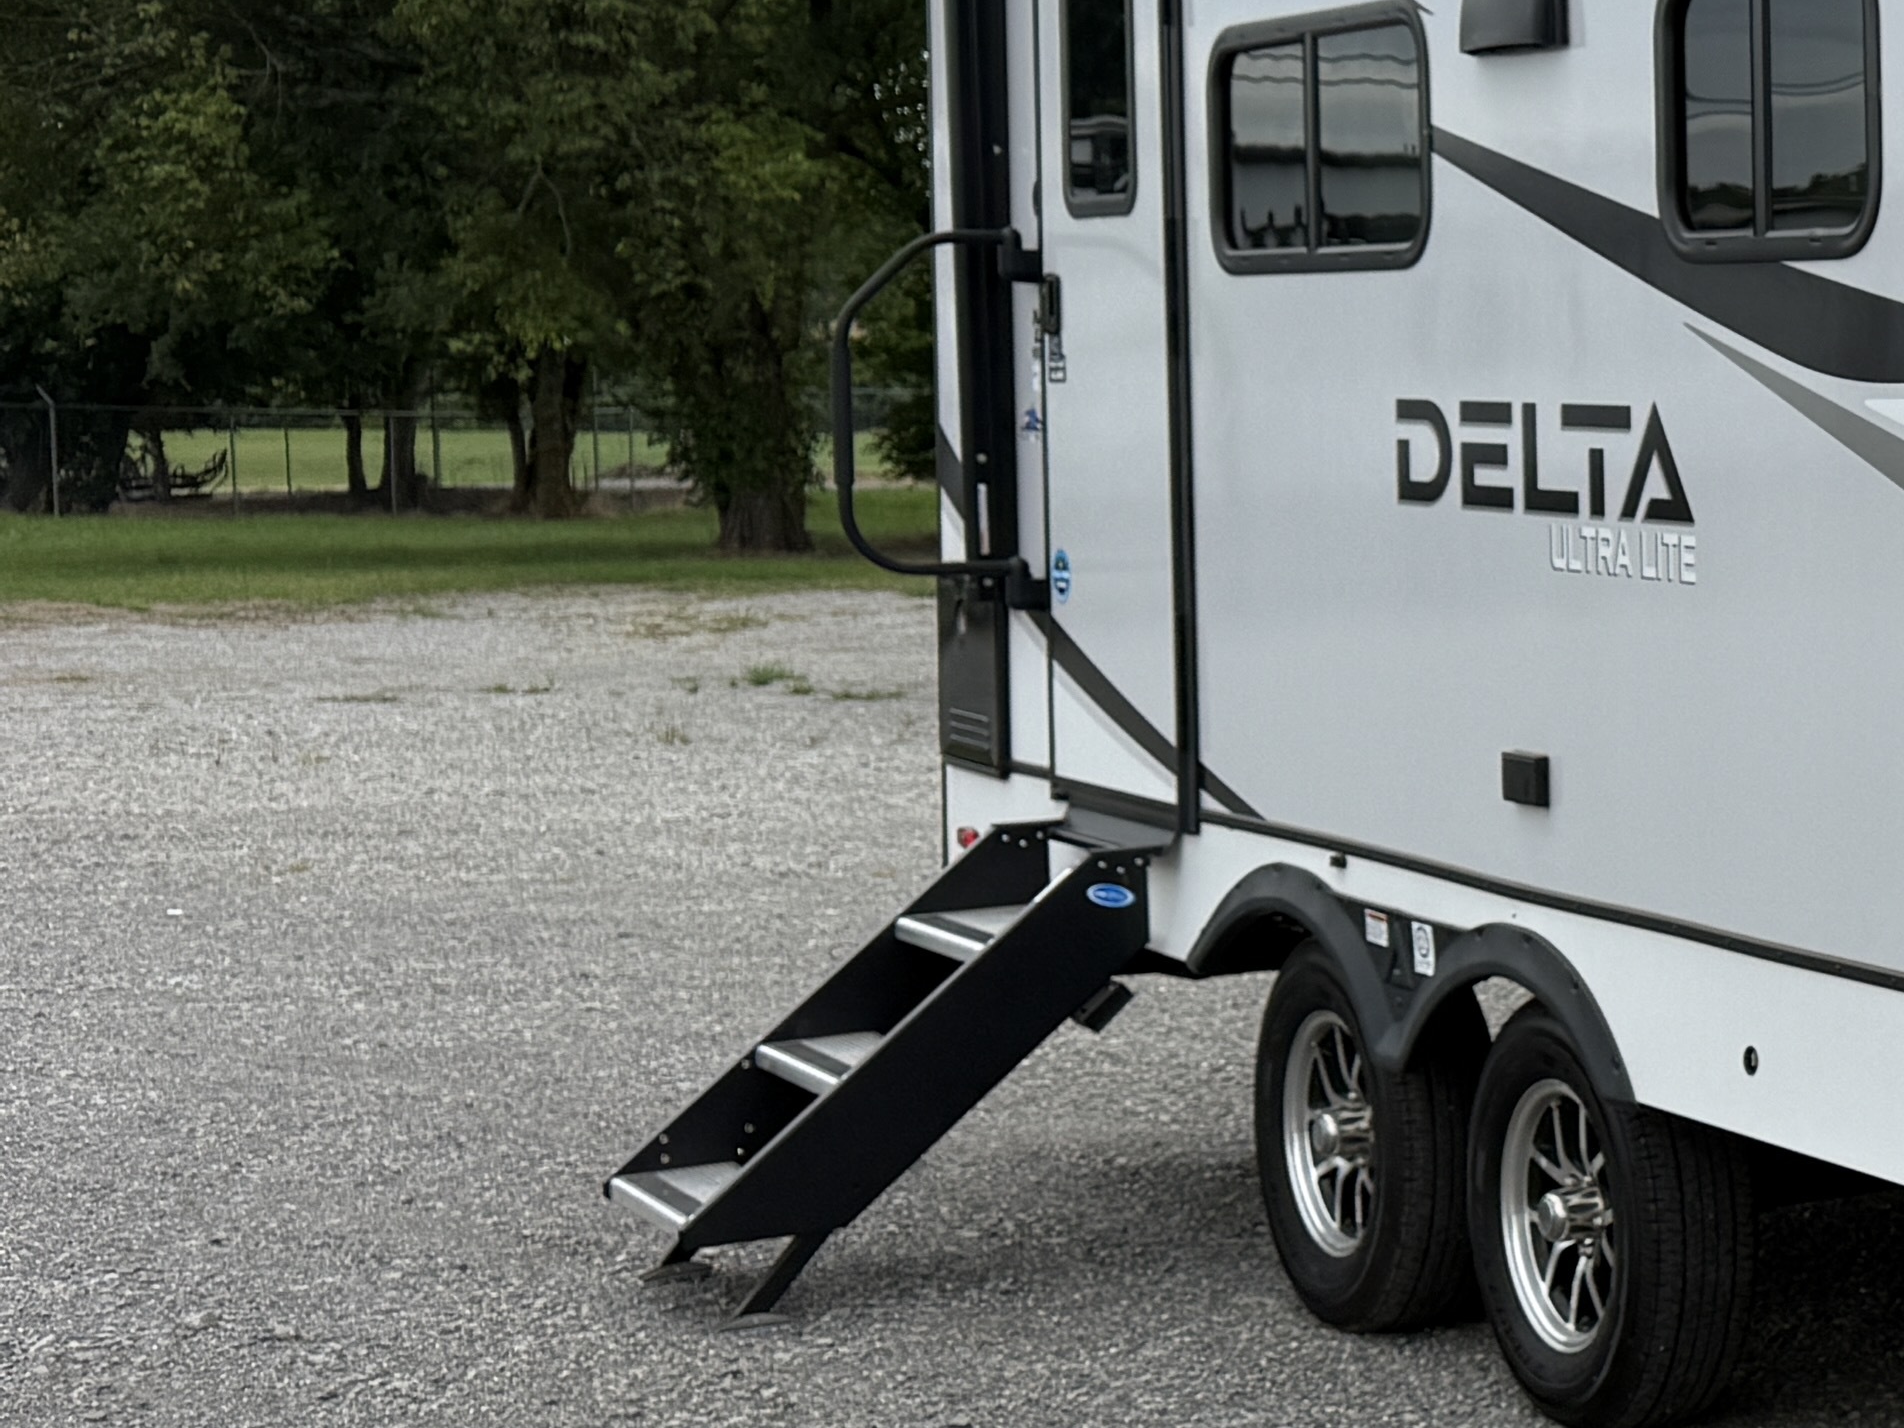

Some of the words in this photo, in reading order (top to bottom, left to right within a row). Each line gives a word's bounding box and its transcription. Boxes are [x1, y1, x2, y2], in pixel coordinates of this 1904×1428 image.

[1396, 398, 1695, 524] DELTA
[1550, 523, 1632, 578] ULTRA
[1640, 530, 1697, 585] LITE
